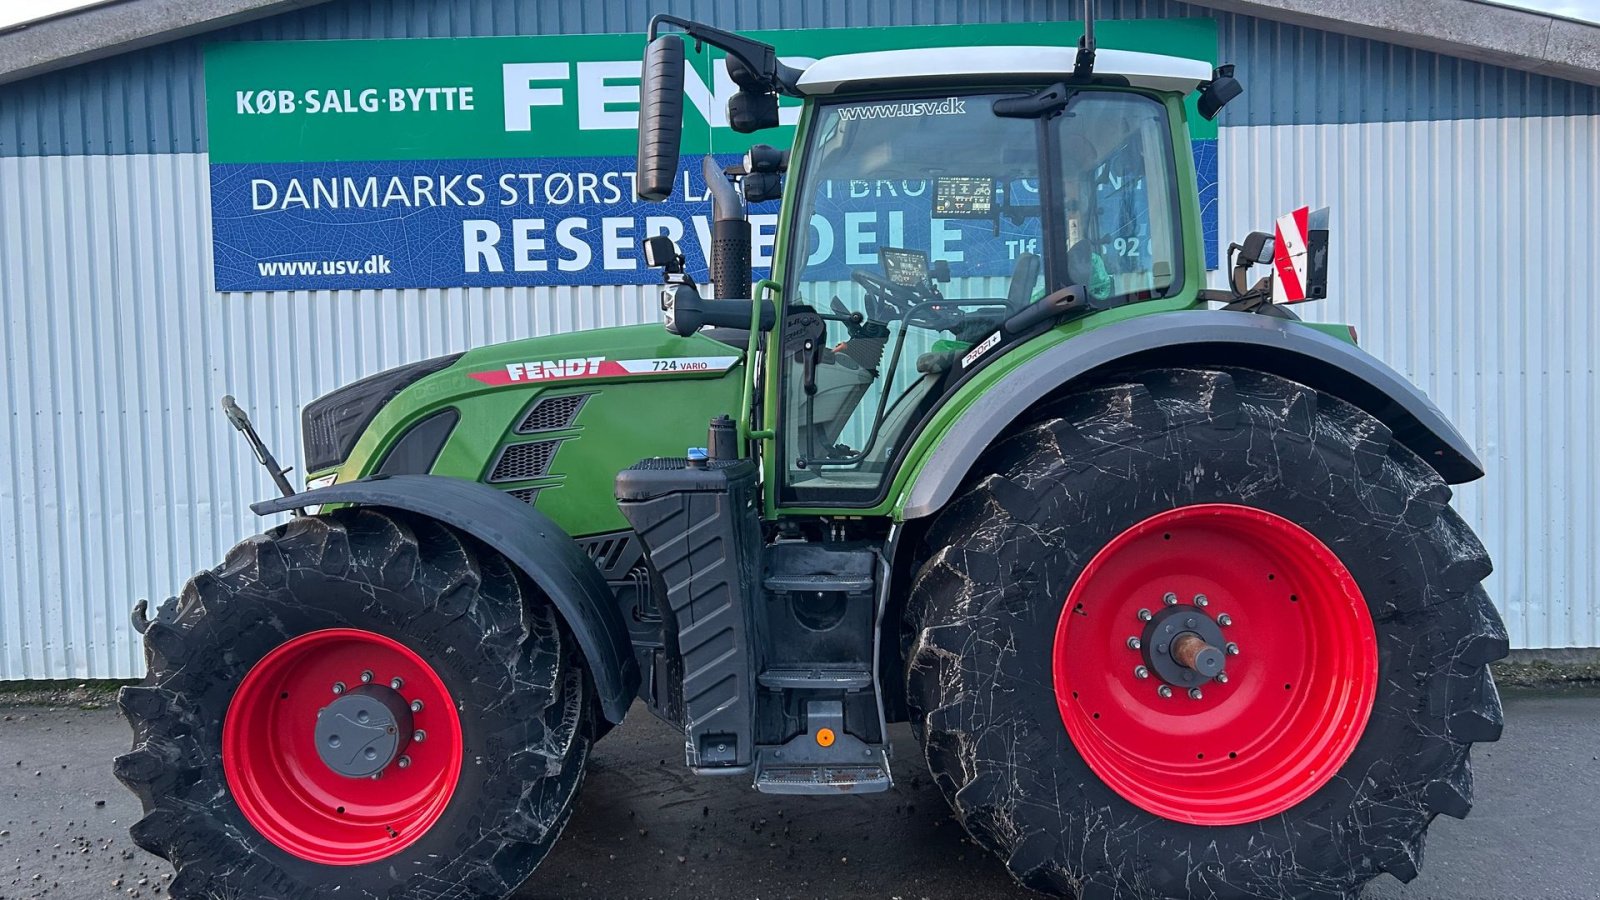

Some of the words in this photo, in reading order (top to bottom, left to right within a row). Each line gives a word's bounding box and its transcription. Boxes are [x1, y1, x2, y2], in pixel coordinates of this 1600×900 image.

[838, 97, 966, 120] www.usv.dk
[251, 174, 486, 211] DANMARKS
[499, 171, 667, 206] STØRST
[1113, 237, 1140, 257] 92
[258, 254, 392, 277] www.usv.dk
[506, 356, 606, 381] FENDT
[652, 360, 677, 371] 724
[680, 361, 708, 371] VARIO
